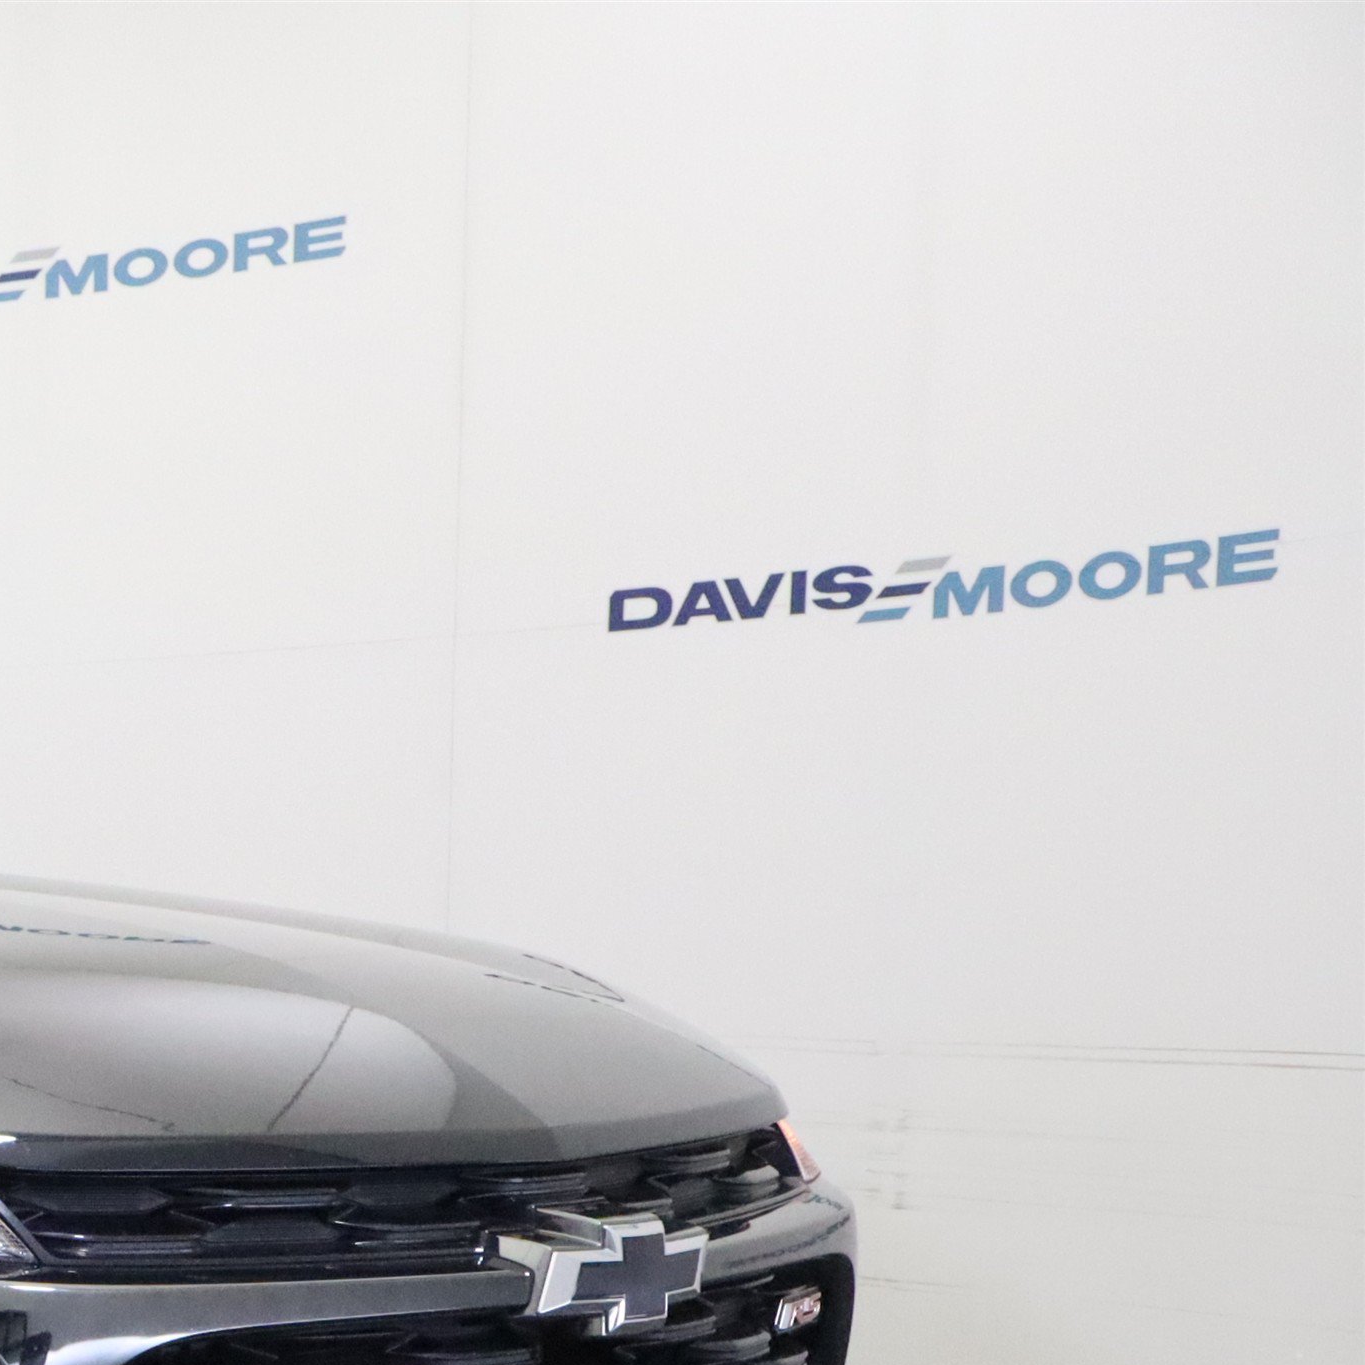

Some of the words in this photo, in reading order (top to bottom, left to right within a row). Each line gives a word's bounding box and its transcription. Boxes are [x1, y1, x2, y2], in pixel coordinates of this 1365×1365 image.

[44, 215, 347, 300] MOORE
[608, 564, 873, 632] DAVIS
[932, 528, 1280, 620] MOORE
